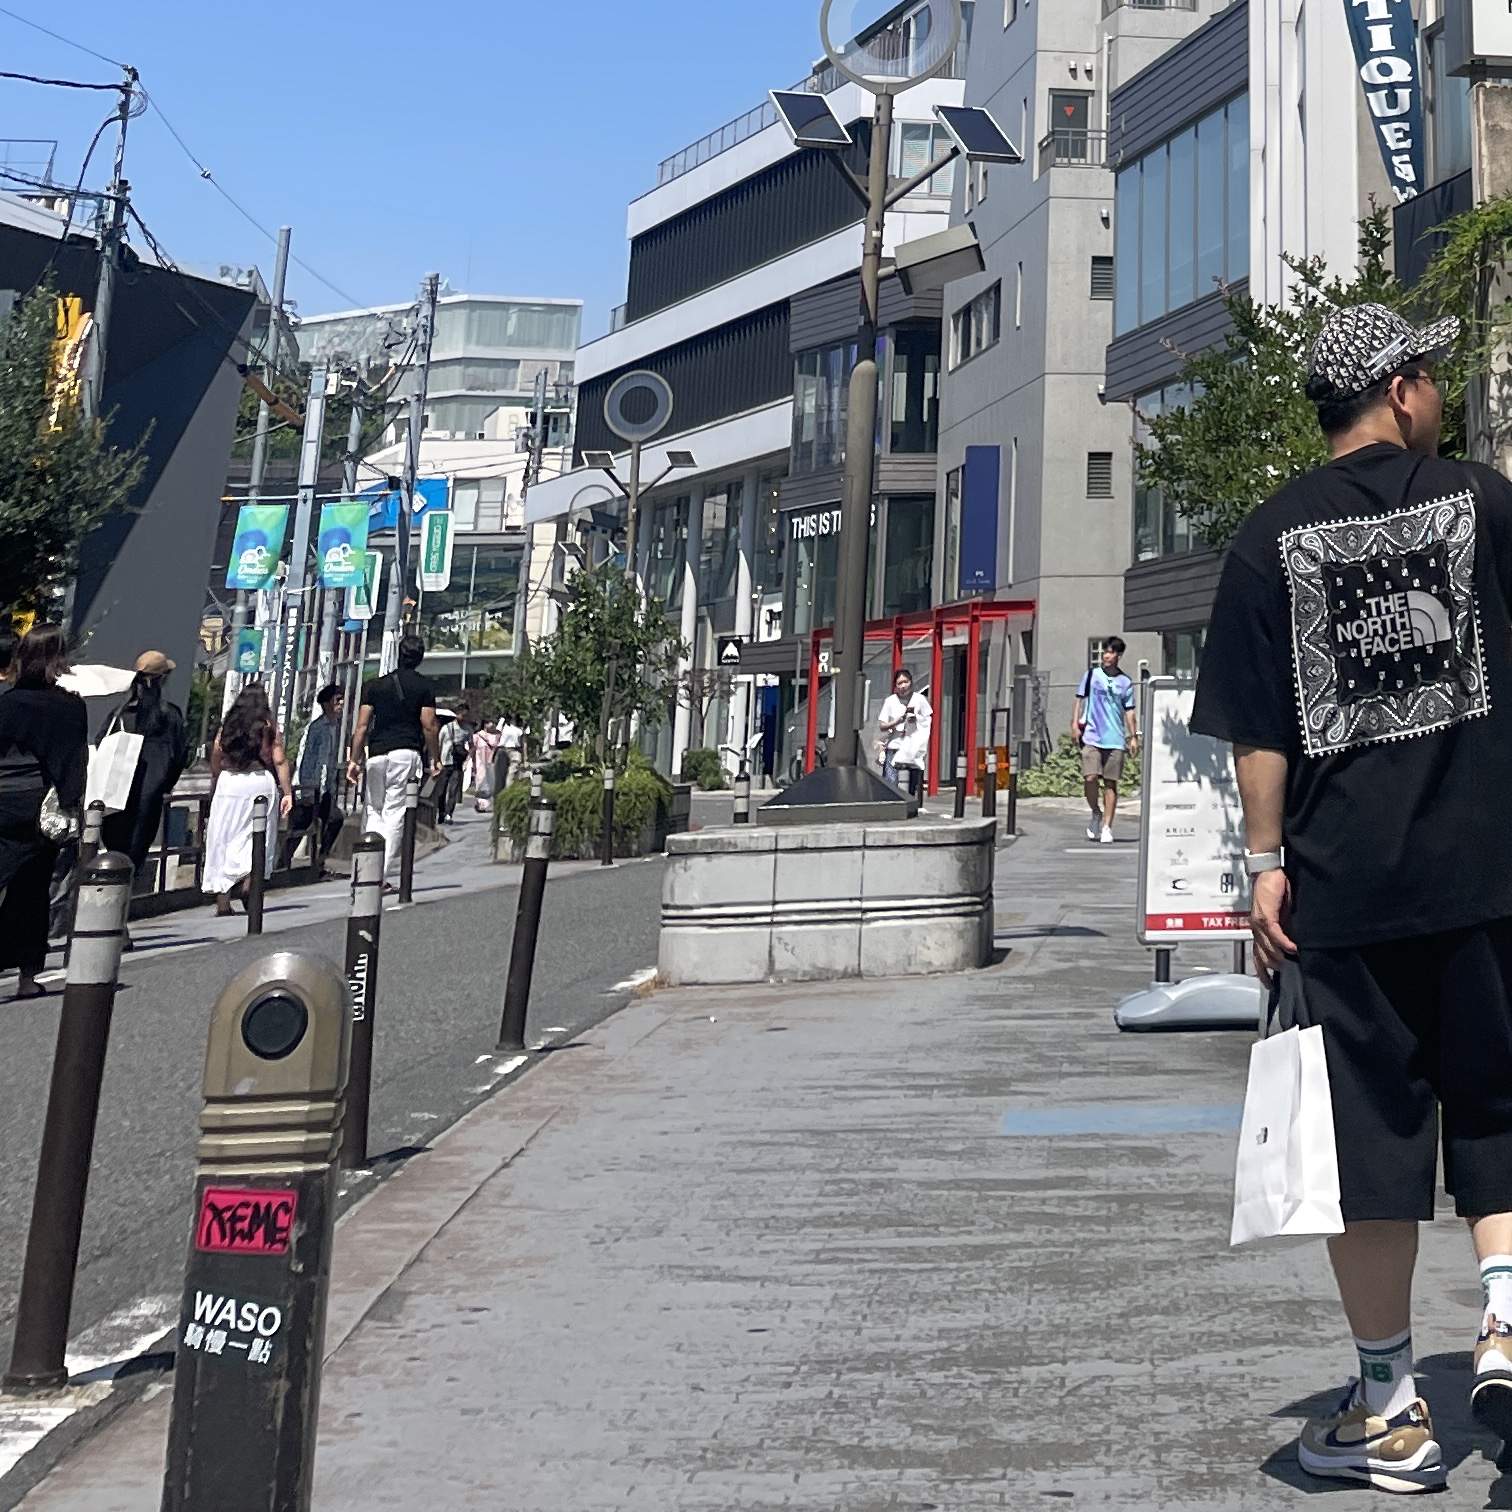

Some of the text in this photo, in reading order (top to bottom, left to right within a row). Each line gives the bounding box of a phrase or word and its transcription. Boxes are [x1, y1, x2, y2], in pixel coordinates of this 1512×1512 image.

[791, 514, 817, 539] THIS
[818, 511, 830, 535] IS
[1365, 591, 1408, 617] THE
[1336, 610, 1411, 643] NORTH
[1359, 631, 1414, 658] FACE
[1202, 917, 1223, 928] TAX
[194, 1289, 282, 1337] WASO
